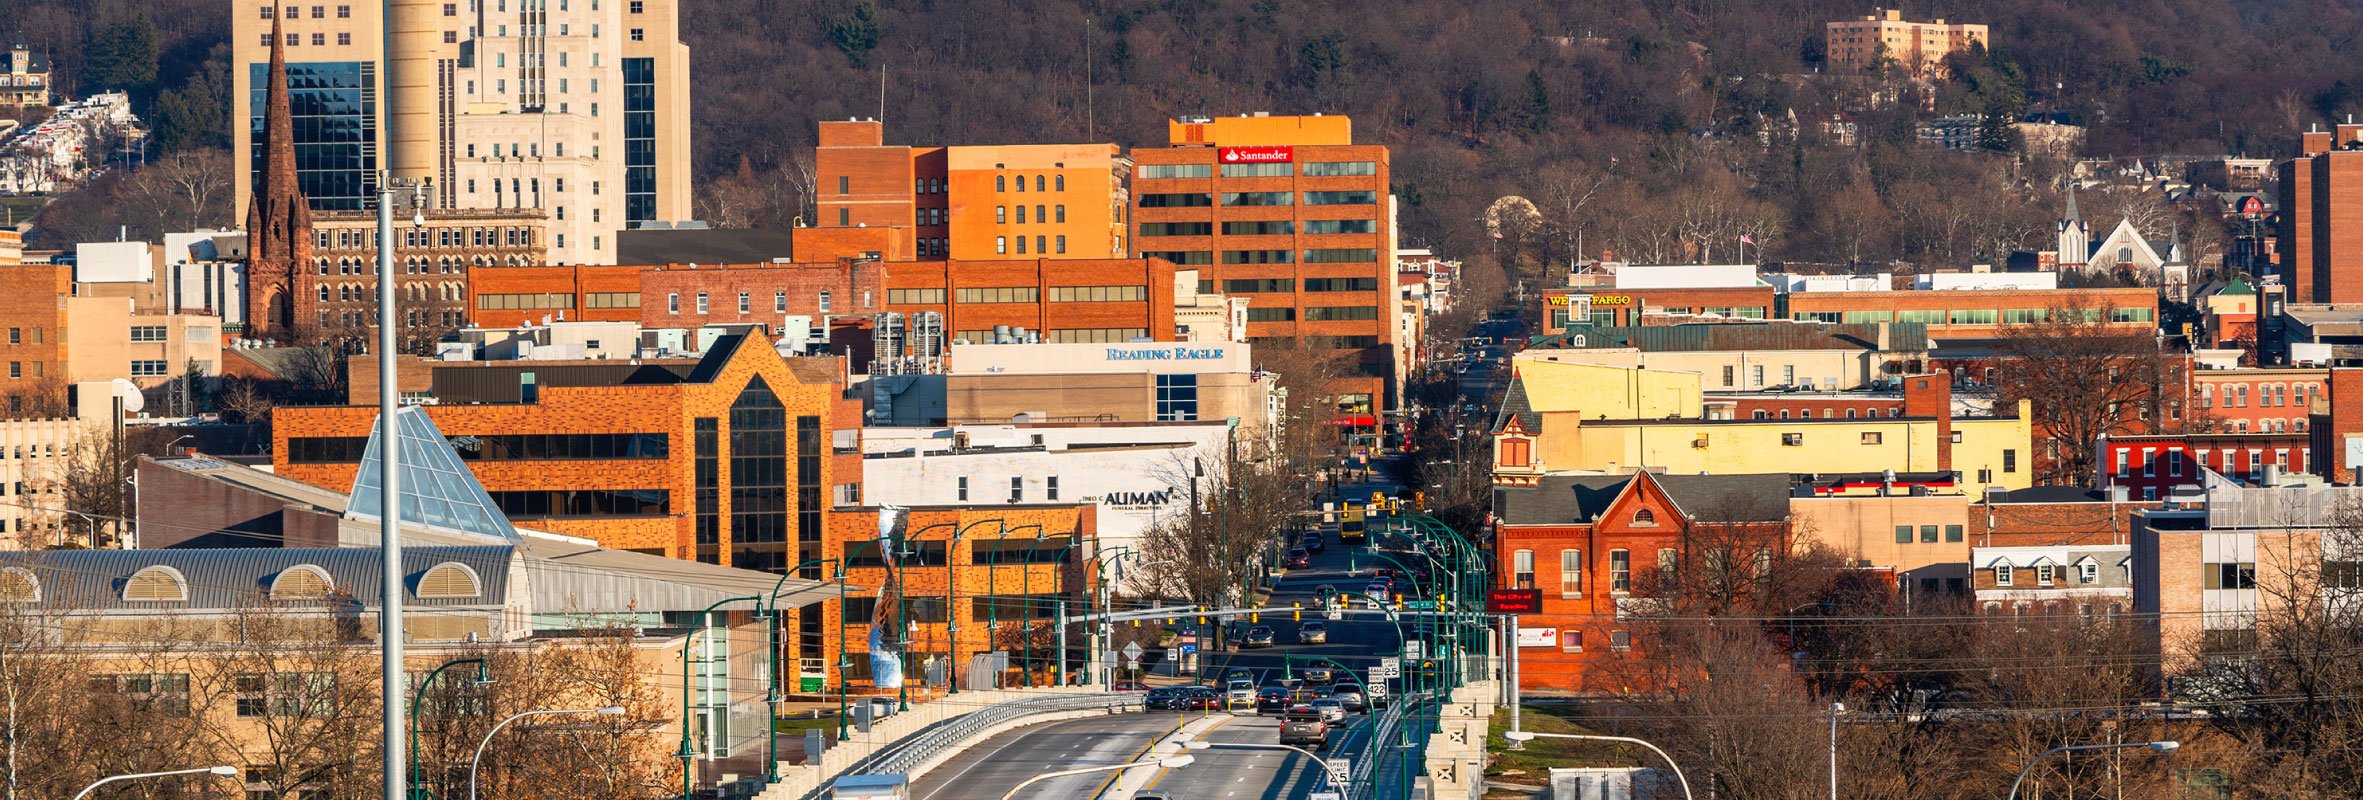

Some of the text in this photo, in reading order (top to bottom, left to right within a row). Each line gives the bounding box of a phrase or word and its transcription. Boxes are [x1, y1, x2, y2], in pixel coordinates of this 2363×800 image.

[1240, 150, 1288, 160] Santander
[1592, 296, 1630, 304] FARGO
[1106, 347, 1224, 360] READING EAGLE
[1104, 491, 1169, 505] AUMAN
